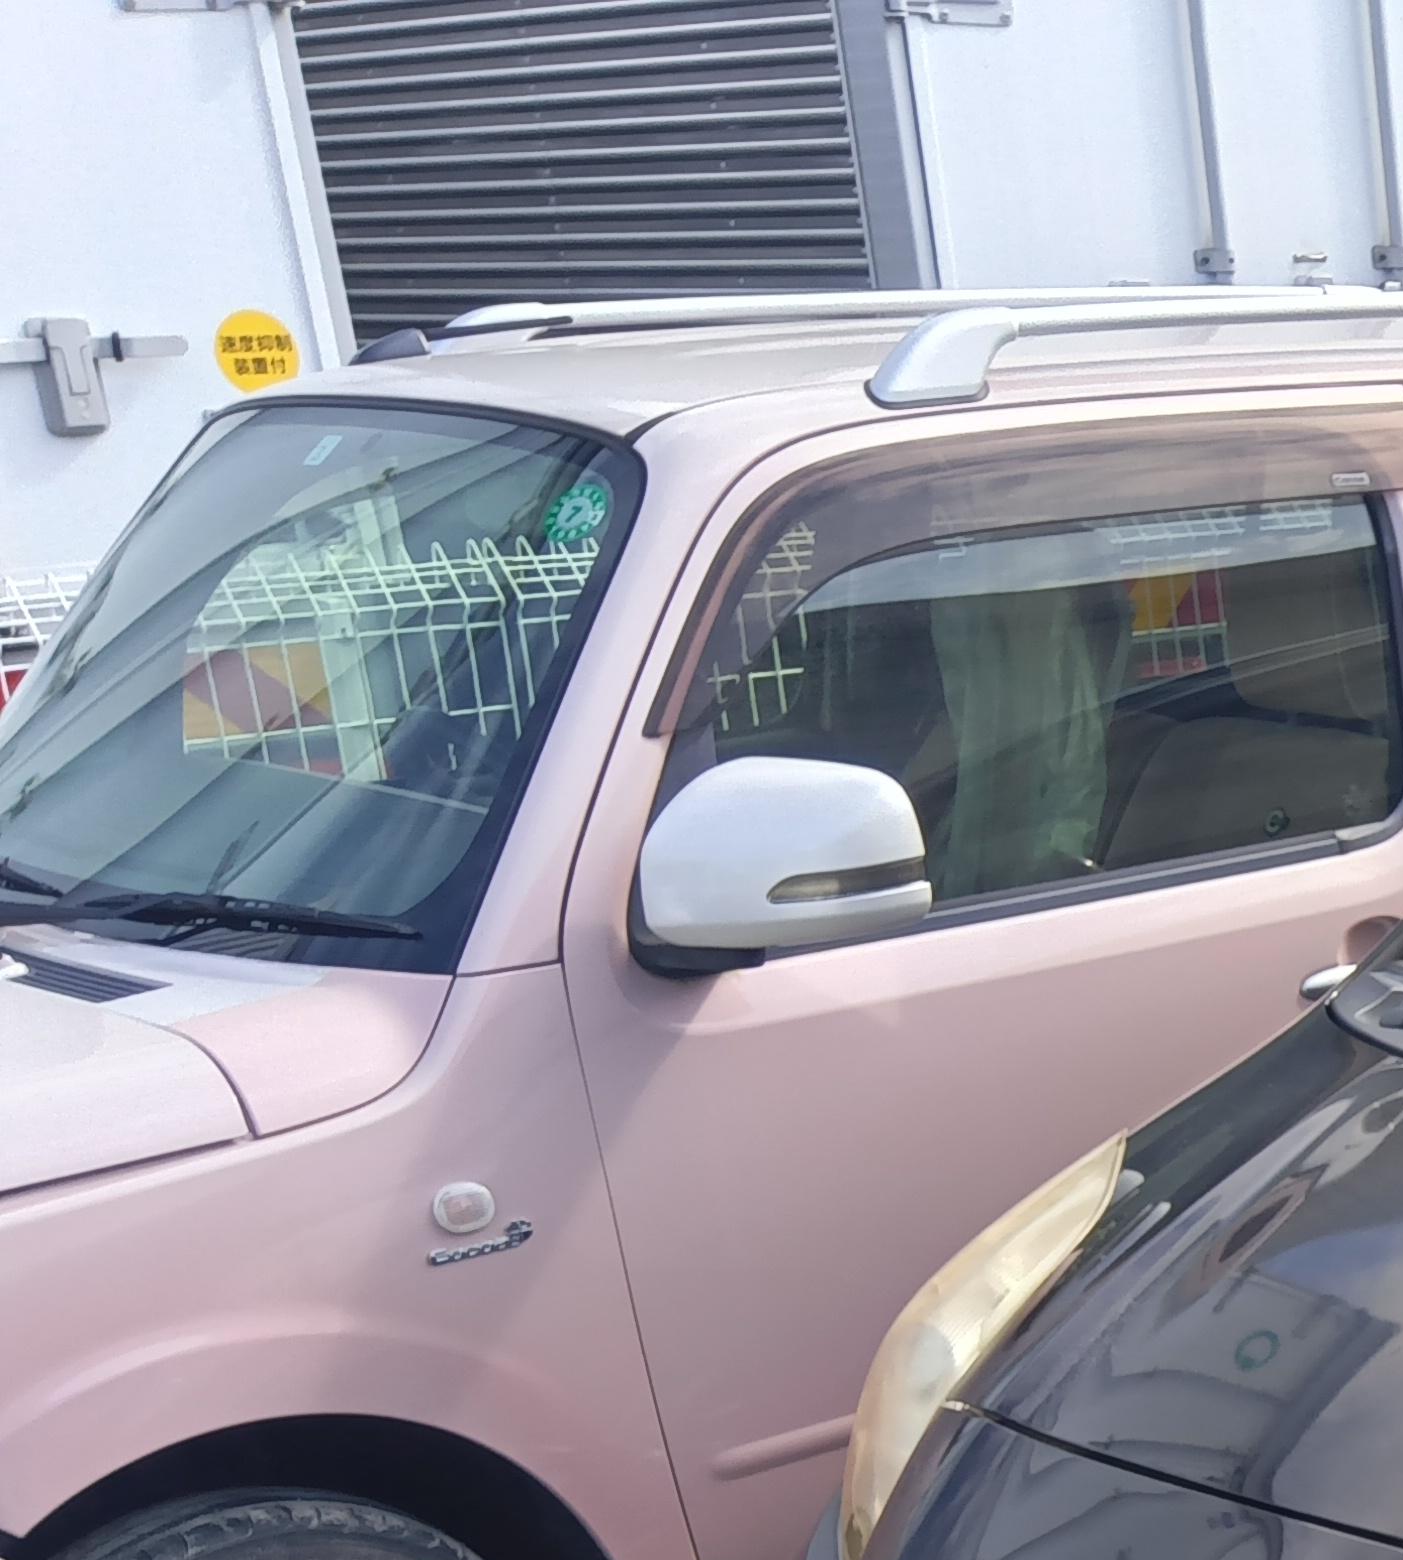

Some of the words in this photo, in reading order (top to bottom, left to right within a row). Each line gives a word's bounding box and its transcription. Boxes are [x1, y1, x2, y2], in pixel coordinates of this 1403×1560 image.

[220, 335, 292, 352] 速度抑制
[234, 357, 285, 375] 装置付
